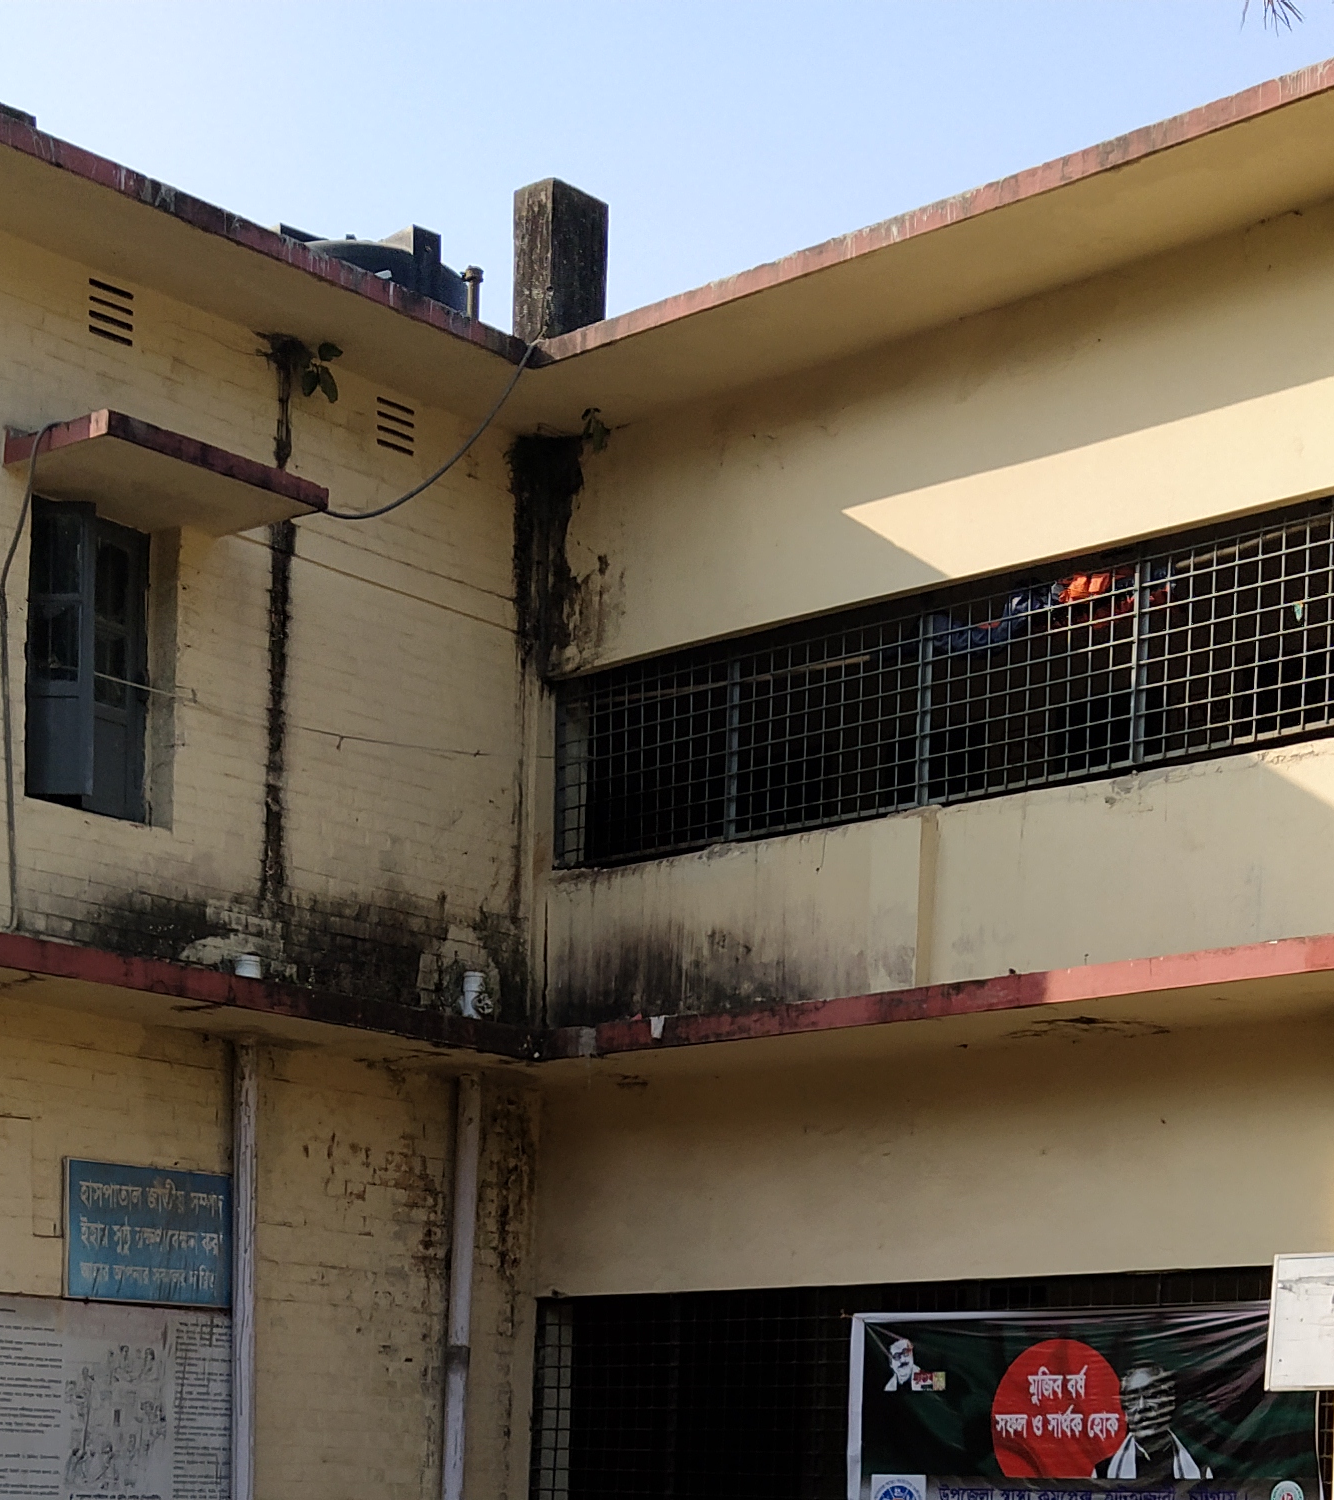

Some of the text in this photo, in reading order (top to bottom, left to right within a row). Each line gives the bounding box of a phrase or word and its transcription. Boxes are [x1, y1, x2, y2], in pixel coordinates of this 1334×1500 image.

[79, 1178, 143, 1211] হাসপাতাল
[1027, 1365, 1088, 1406] মুজিব বর্ষ
[995, 1404, 1119, 1441] সফল ও সার্থক হোক
